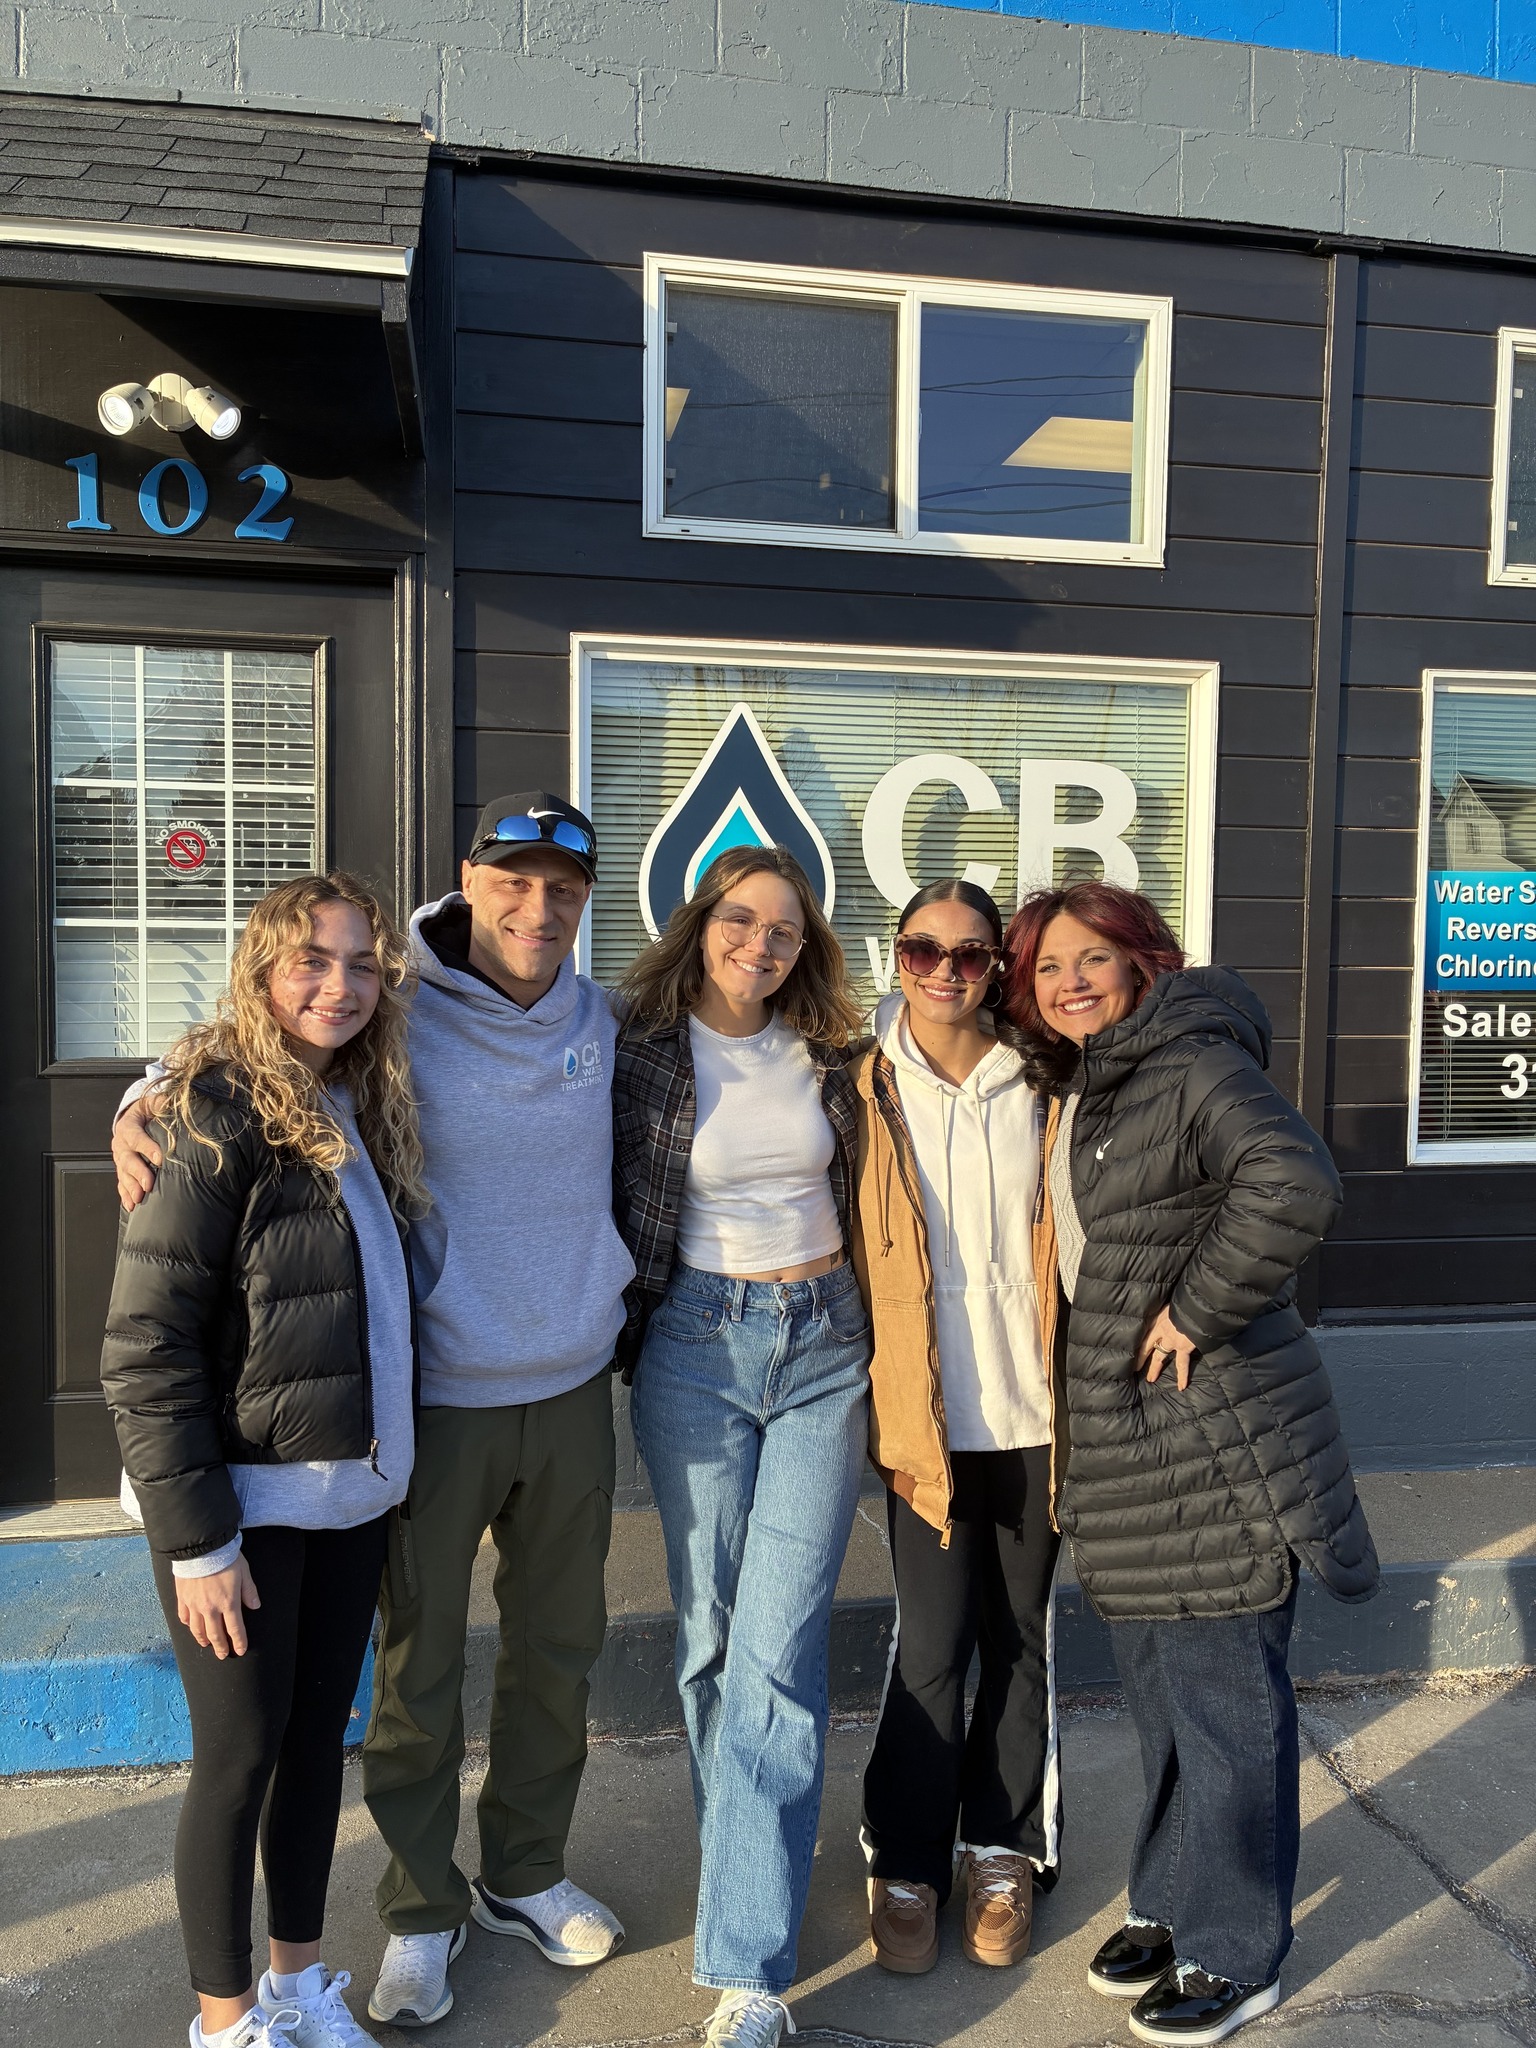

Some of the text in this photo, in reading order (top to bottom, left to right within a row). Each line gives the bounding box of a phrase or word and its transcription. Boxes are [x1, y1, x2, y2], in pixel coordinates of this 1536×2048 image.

[65, 452, 294, 542] 102
[155, 820, 218, 848] NO SMOKING
[861, 753, 1140, 915] CB
[1434, 879, 1536, 904] Water S
[1447, 916, 1536, 941] Revers
[1436, 953, 1536, 978] Chlorin
[1442, 1003, 1532, 1038] Sale
[581, 1041, 602, 1067] CB
[560, 1074, 605, 1092] TREATMENT
[1500, 1053, 1536, 1099] 3
